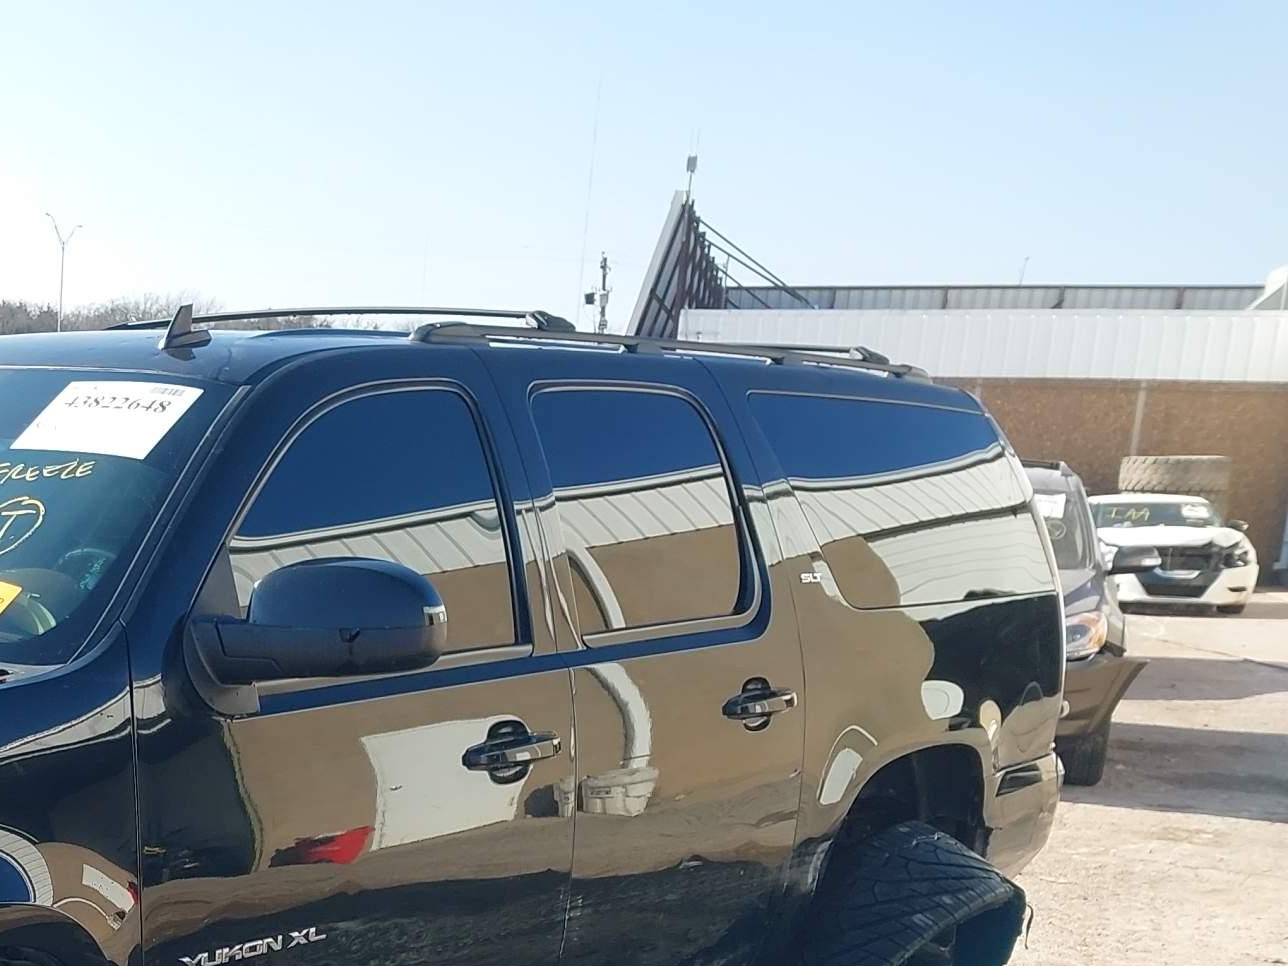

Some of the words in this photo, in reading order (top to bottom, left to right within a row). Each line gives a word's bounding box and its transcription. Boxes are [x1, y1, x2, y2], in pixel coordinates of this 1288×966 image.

[64, 396, 172, 413] 43822648
[800, 572, 821, 584] SLT
[286, 927, 327, 949] XL
